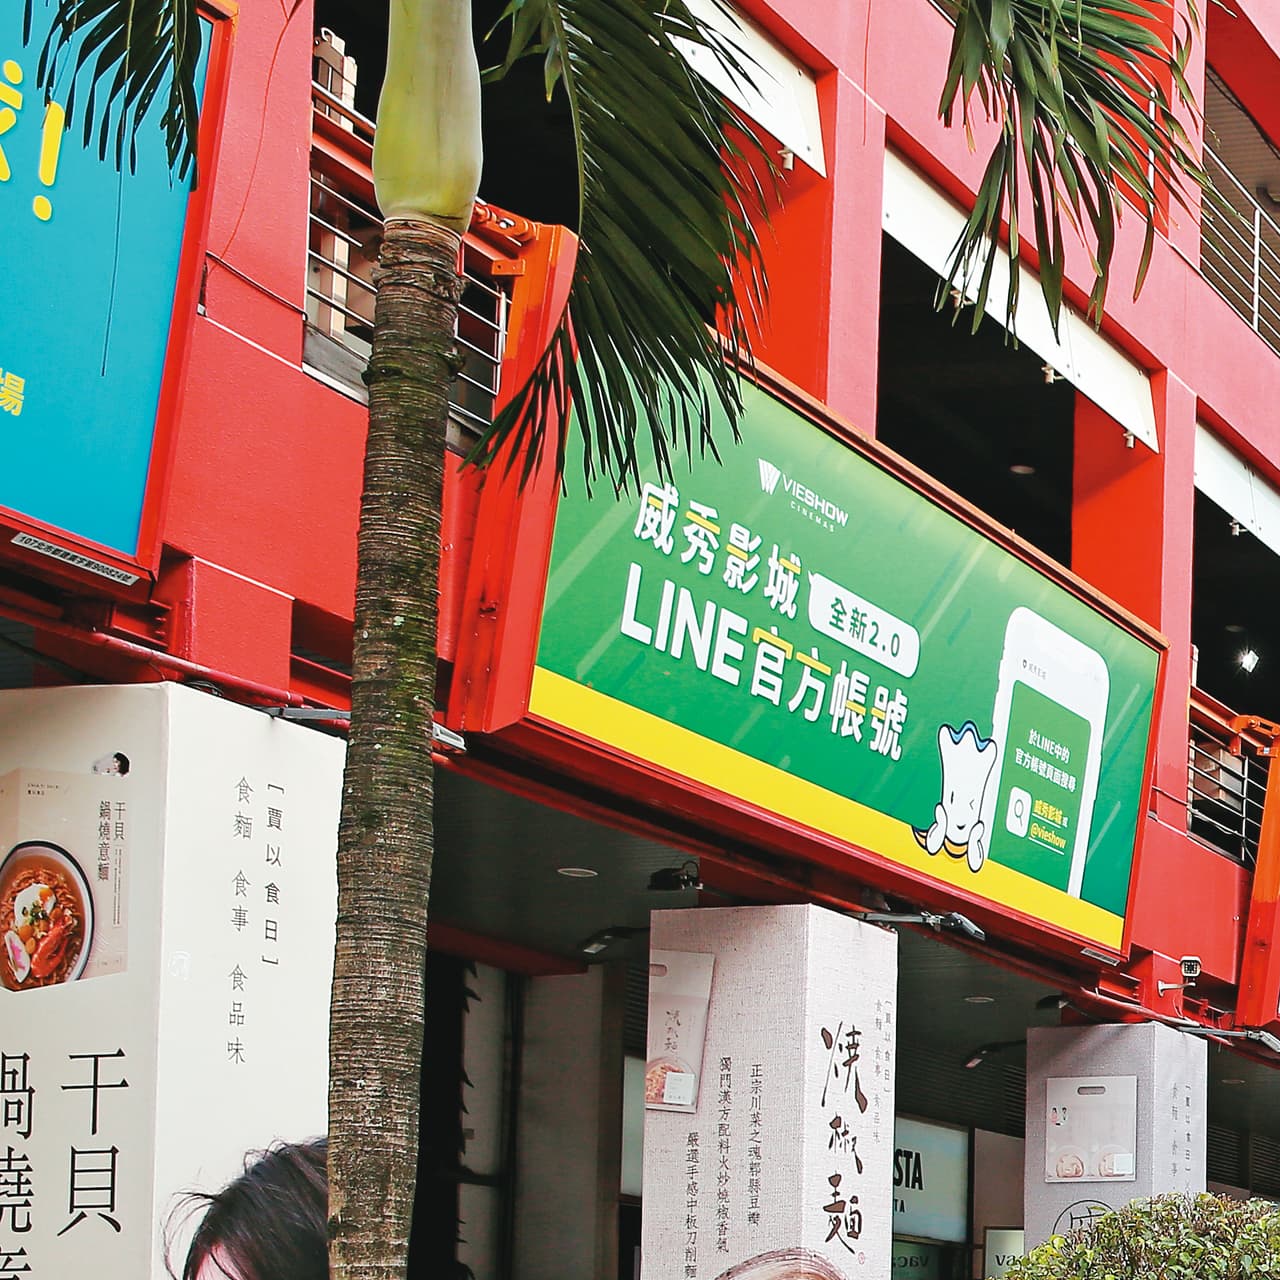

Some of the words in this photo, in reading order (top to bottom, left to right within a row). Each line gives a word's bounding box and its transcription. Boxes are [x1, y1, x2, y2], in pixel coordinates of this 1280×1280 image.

[782, 473, 848, 527] VIESHOW
[633, 481, 802, 622] 威秀影城
[619, 562, 909, 762] LINE官方帳號
[828, 594, 902, 660] 全新2.0
[1030, 822, 1067, 850] @vieshow
[230, 869, 250, 932] 食事
[227, 964, 249, 1065] 食品味
[57, 1047, 129, 1237] 干貝
